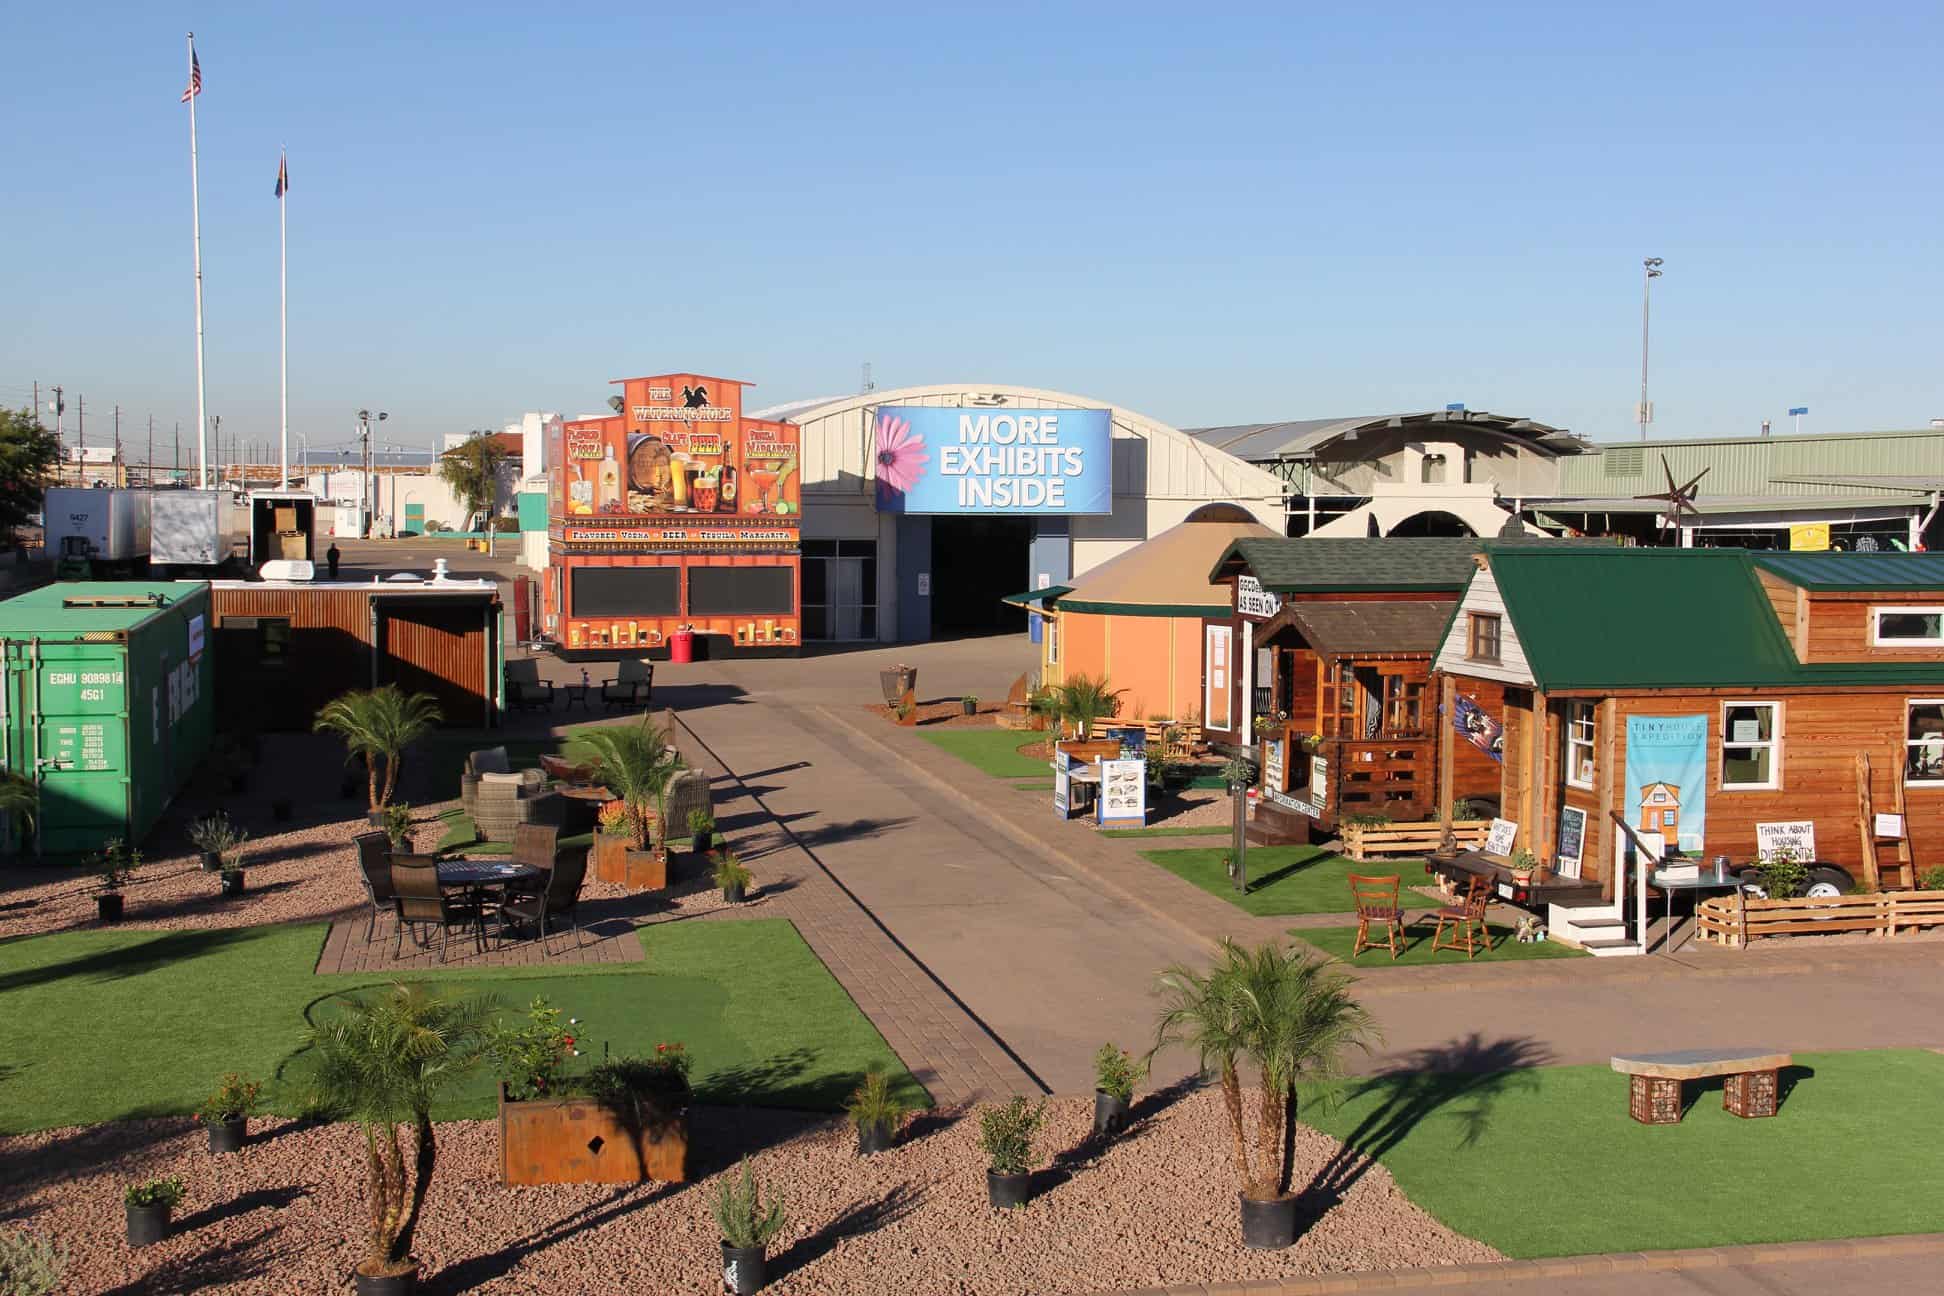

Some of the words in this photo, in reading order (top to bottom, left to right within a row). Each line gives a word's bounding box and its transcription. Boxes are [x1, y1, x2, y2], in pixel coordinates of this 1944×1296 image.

[633, 407, 698, 421] WATERING
[959, 415, 1058, 444] MORE
[690, 435, 720, 453] BEER
[940, 446, 1083, 476] EXHIBITS
[958, 478, 1066, 507] INSIDE
[1240, 595, 1247, 610] AS
[1248, 597, 1263, 613] SEEN
[1265, 599, 1274, 615] ON
[80, 689, 104, 700] 45G1
[1759, 825, 1785, 835] THINK
[1789, 824, 1811, 834] ABOUT
[1771, 836, 1802, 847] HOUSING
